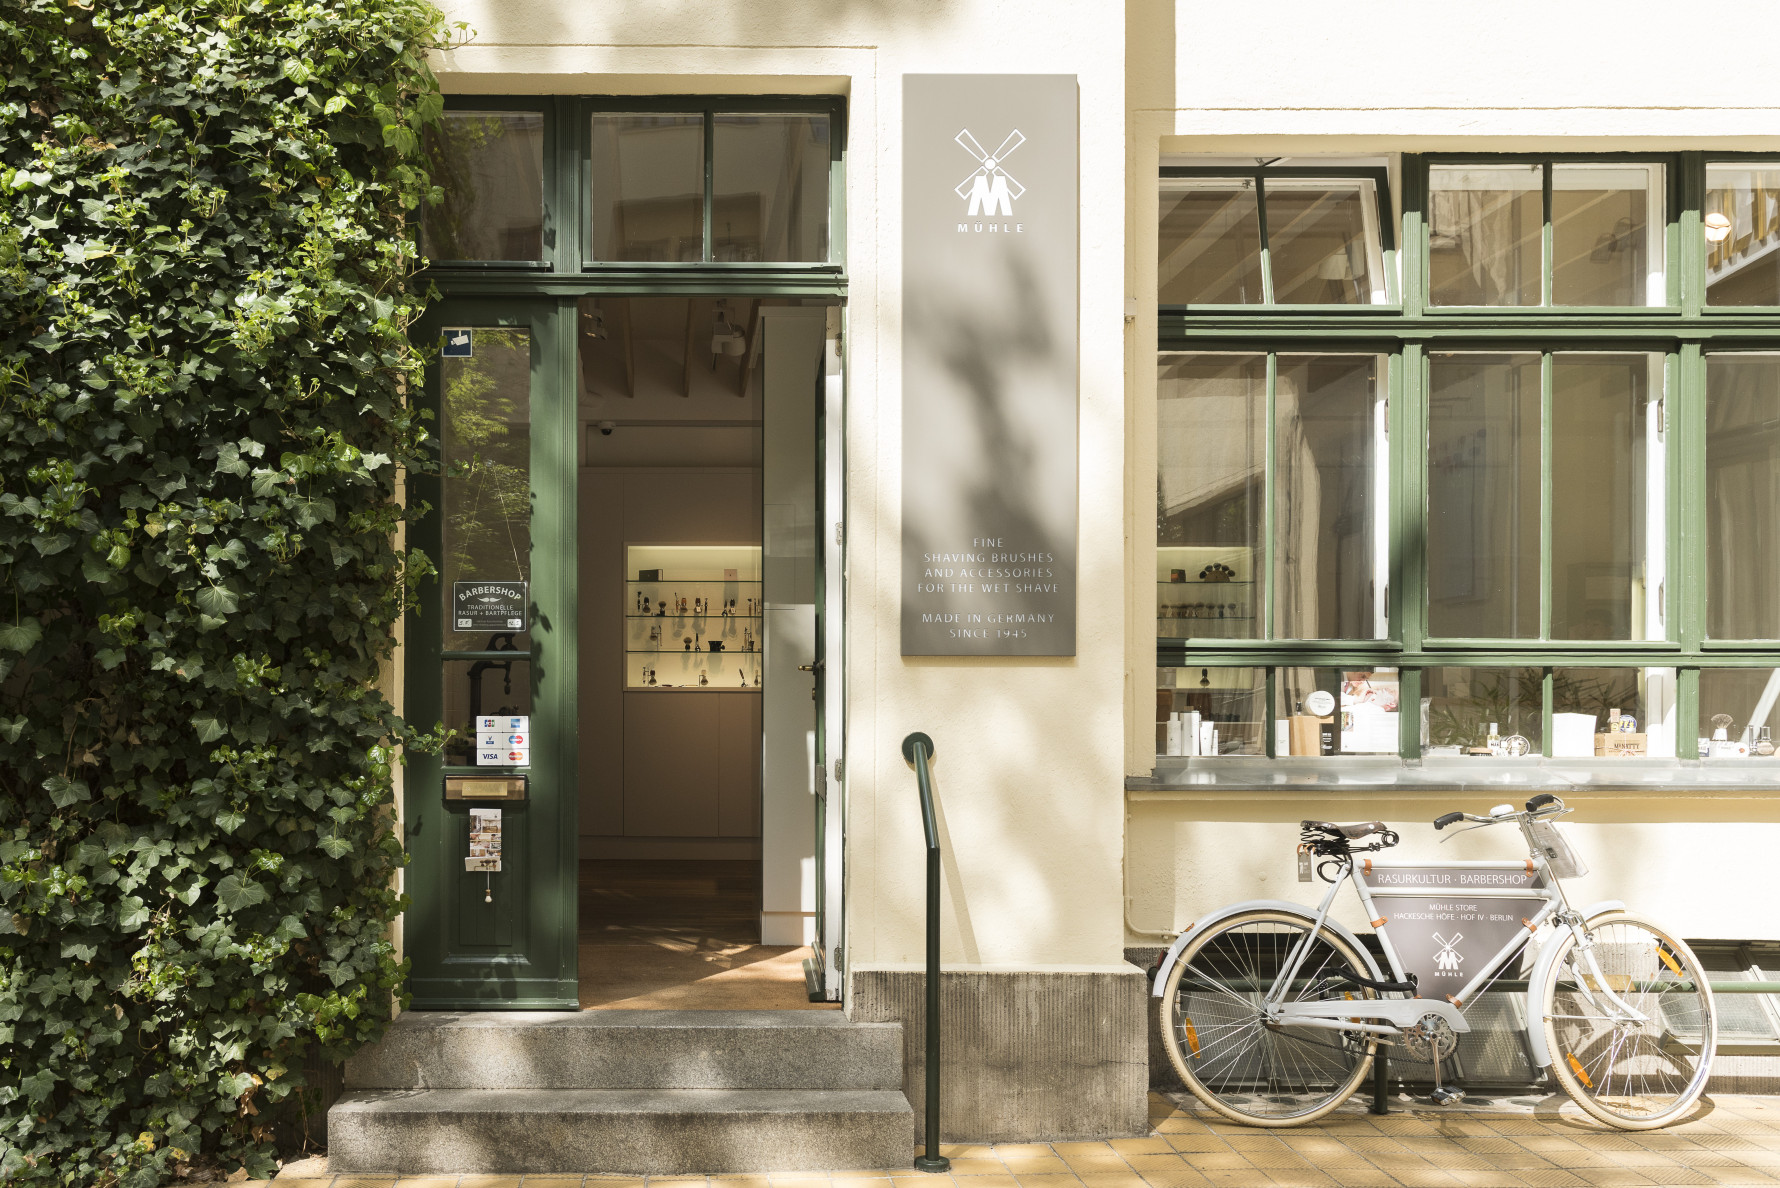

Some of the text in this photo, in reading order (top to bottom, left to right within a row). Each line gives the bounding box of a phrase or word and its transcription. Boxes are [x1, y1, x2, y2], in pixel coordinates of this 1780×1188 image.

[957, 221, 1024, 233] MÜHLE
[973, 537, 1004, 548] FINE
[924, 553, 1054, 563] SHAVING BRUSHES
[924, 568, 1053, 578] AND ACCESSORIES
[917, 583, 1059, 593] FOR THE WET SHAVE
[458, 586, 522, 602] BARBERSHOP
[922, 613, 1056, 623] MADE IN GERMANY
[949, 629, 1028, 638] SINCE 1945
[1377, 873, 1527, 885] RASURKULTUR BARBERSHOP
[1429, 902, 1478, 912] MÜHLE STORE
[1393, 912, 1514, 922] HACKESCHE HÖFE HOF IV BERLIN
